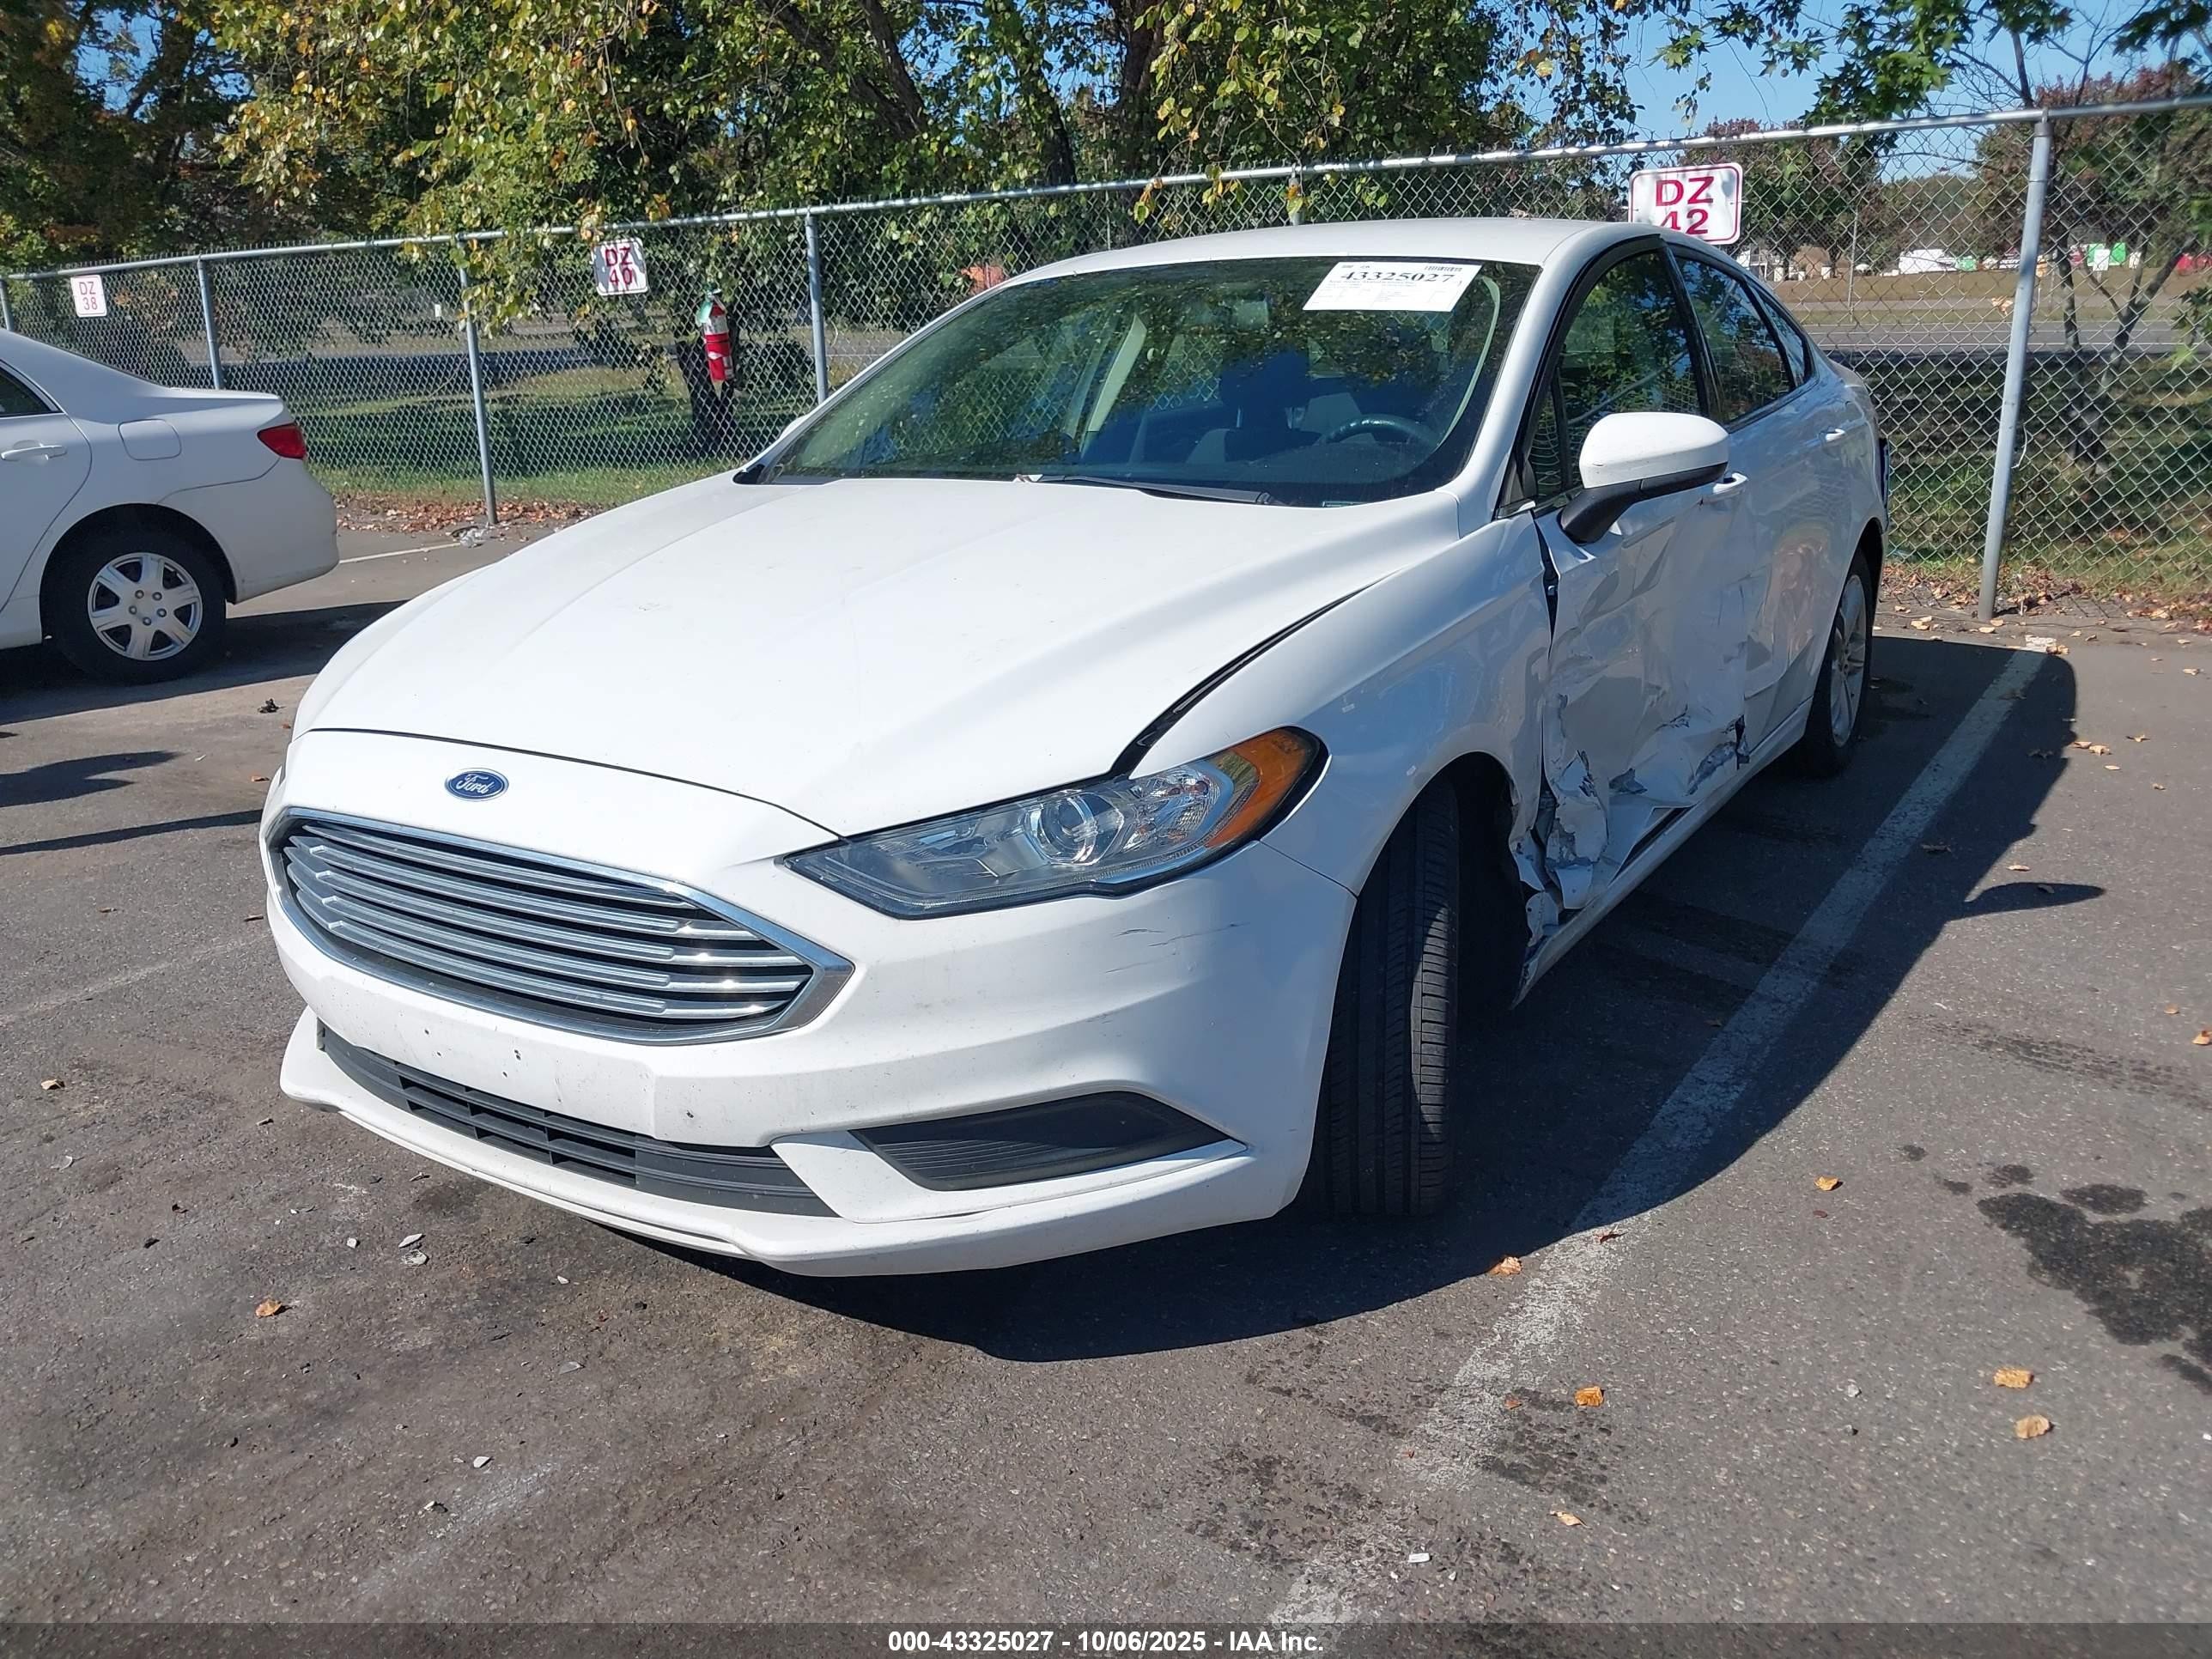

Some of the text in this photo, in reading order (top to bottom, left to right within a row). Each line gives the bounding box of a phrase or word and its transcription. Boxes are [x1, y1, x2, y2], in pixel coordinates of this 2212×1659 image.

[1656, 176, 1714, 207] DZ
[1660, 209, 1709, 234] 42
[605, 246, 633, 266] DZ
[610, 267, 633, 285] 40
[1340, 271, 1455, 283] 43325027
[78, 281, 96, 295] DZ
[82, 297, 98, 310] 38
[456, 774, 495, 793] Ford
